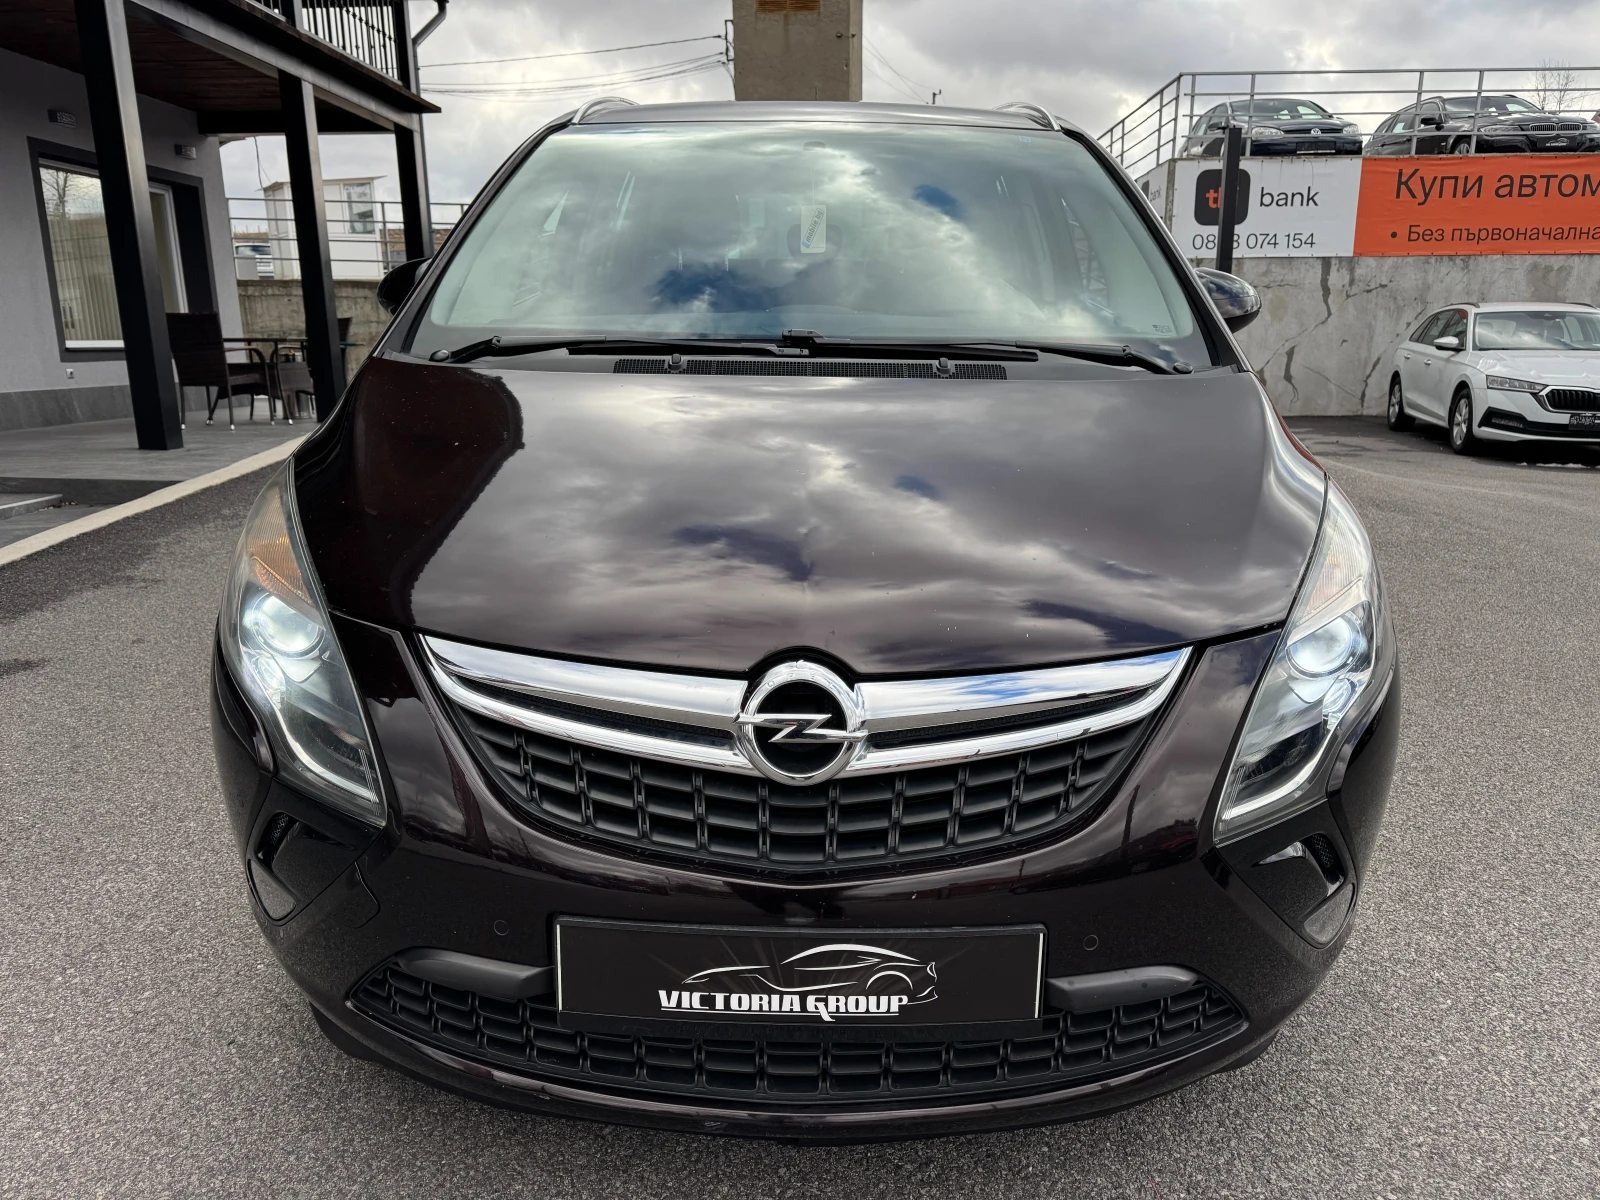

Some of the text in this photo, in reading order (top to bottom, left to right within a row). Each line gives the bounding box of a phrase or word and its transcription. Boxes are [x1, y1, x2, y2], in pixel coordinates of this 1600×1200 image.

[1259, 186, 1320, 207] bank
[1395, 168, 1483, 206] Купи
[1192, 233, 1316, 250] 088 074 154
[1407, 224, 1600, 245] Без първоначална
[658, 990, 908, 1021] VICTORIA GROUP
